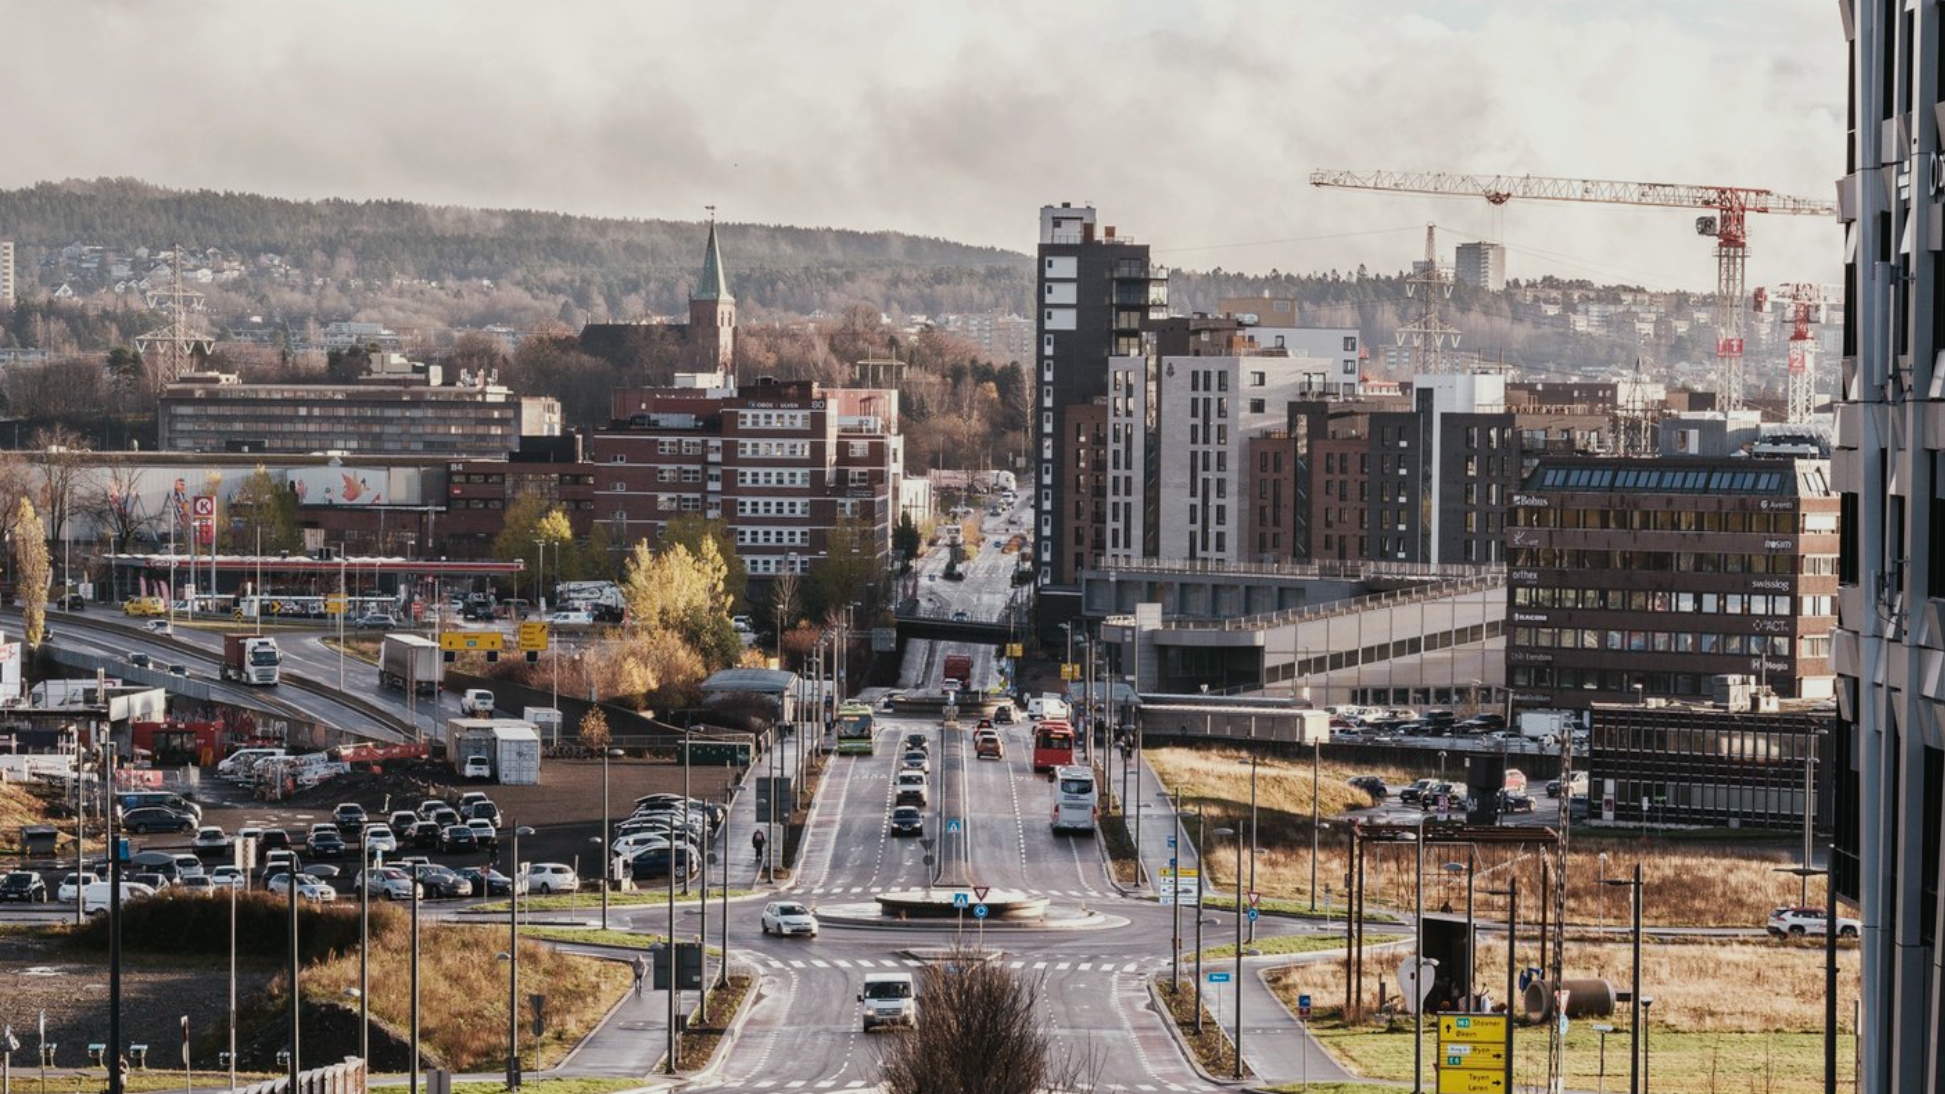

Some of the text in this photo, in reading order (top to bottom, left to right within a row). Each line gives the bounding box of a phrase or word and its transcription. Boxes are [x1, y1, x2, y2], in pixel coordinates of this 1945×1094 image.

[811, 400, 825, 409] 80
[451, 463, 463, 471] 84
[1520, 495, 1549, 506] Bohus
[1513, 570, 1538, 579] orthex
[1752, 580, 1790, 592] swisslog
[1472, 1019, 1501, 1027] Stovner
